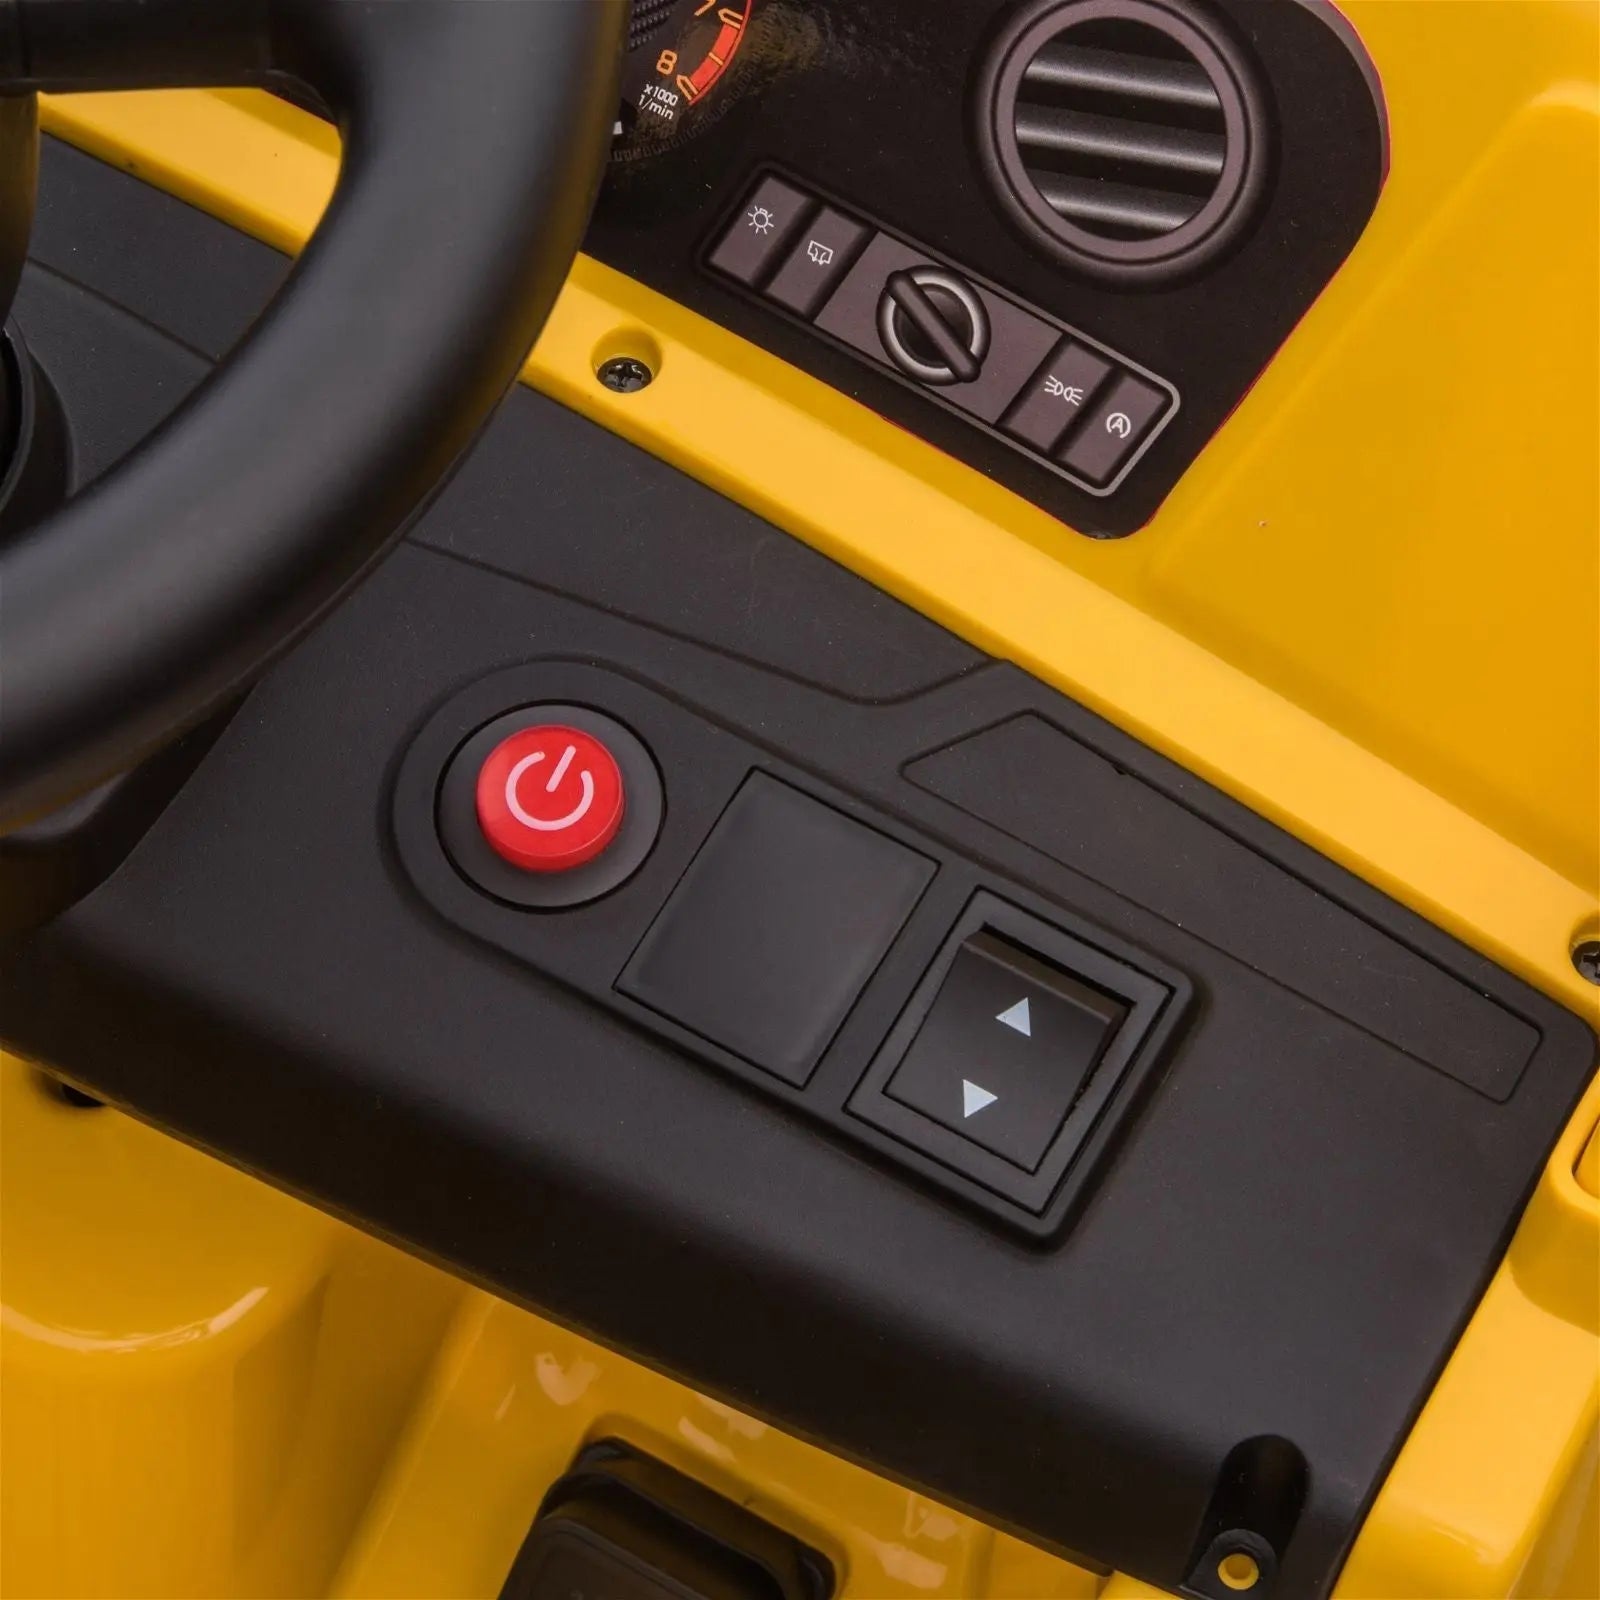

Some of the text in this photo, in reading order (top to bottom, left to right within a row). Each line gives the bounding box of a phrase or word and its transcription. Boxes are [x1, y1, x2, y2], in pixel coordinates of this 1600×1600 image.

[656, 49, 678, 75] 8
[638, 94, 674, 120] 1/min
[643, 83, 679, 107] x1000
